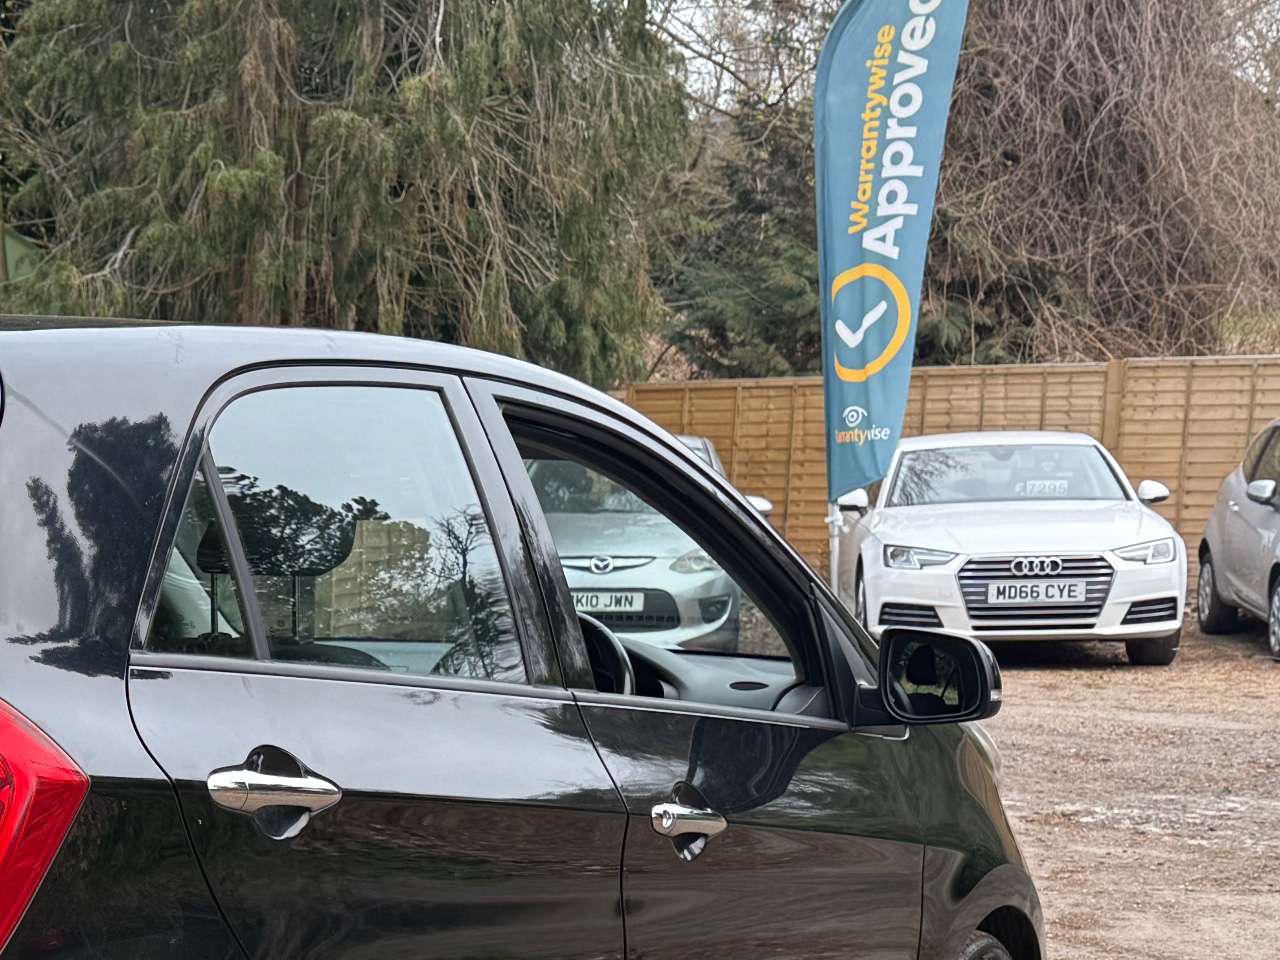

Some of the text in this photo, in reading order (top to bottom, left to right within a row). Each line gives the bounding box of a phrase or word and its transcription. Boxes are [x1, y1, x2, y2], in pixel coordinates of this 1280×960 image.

[847, 24, 896, 234] Warrantywise
[996, 584, 1078, 600] MD66 CYE
[571, 594, 634, 608] K10 JWN
